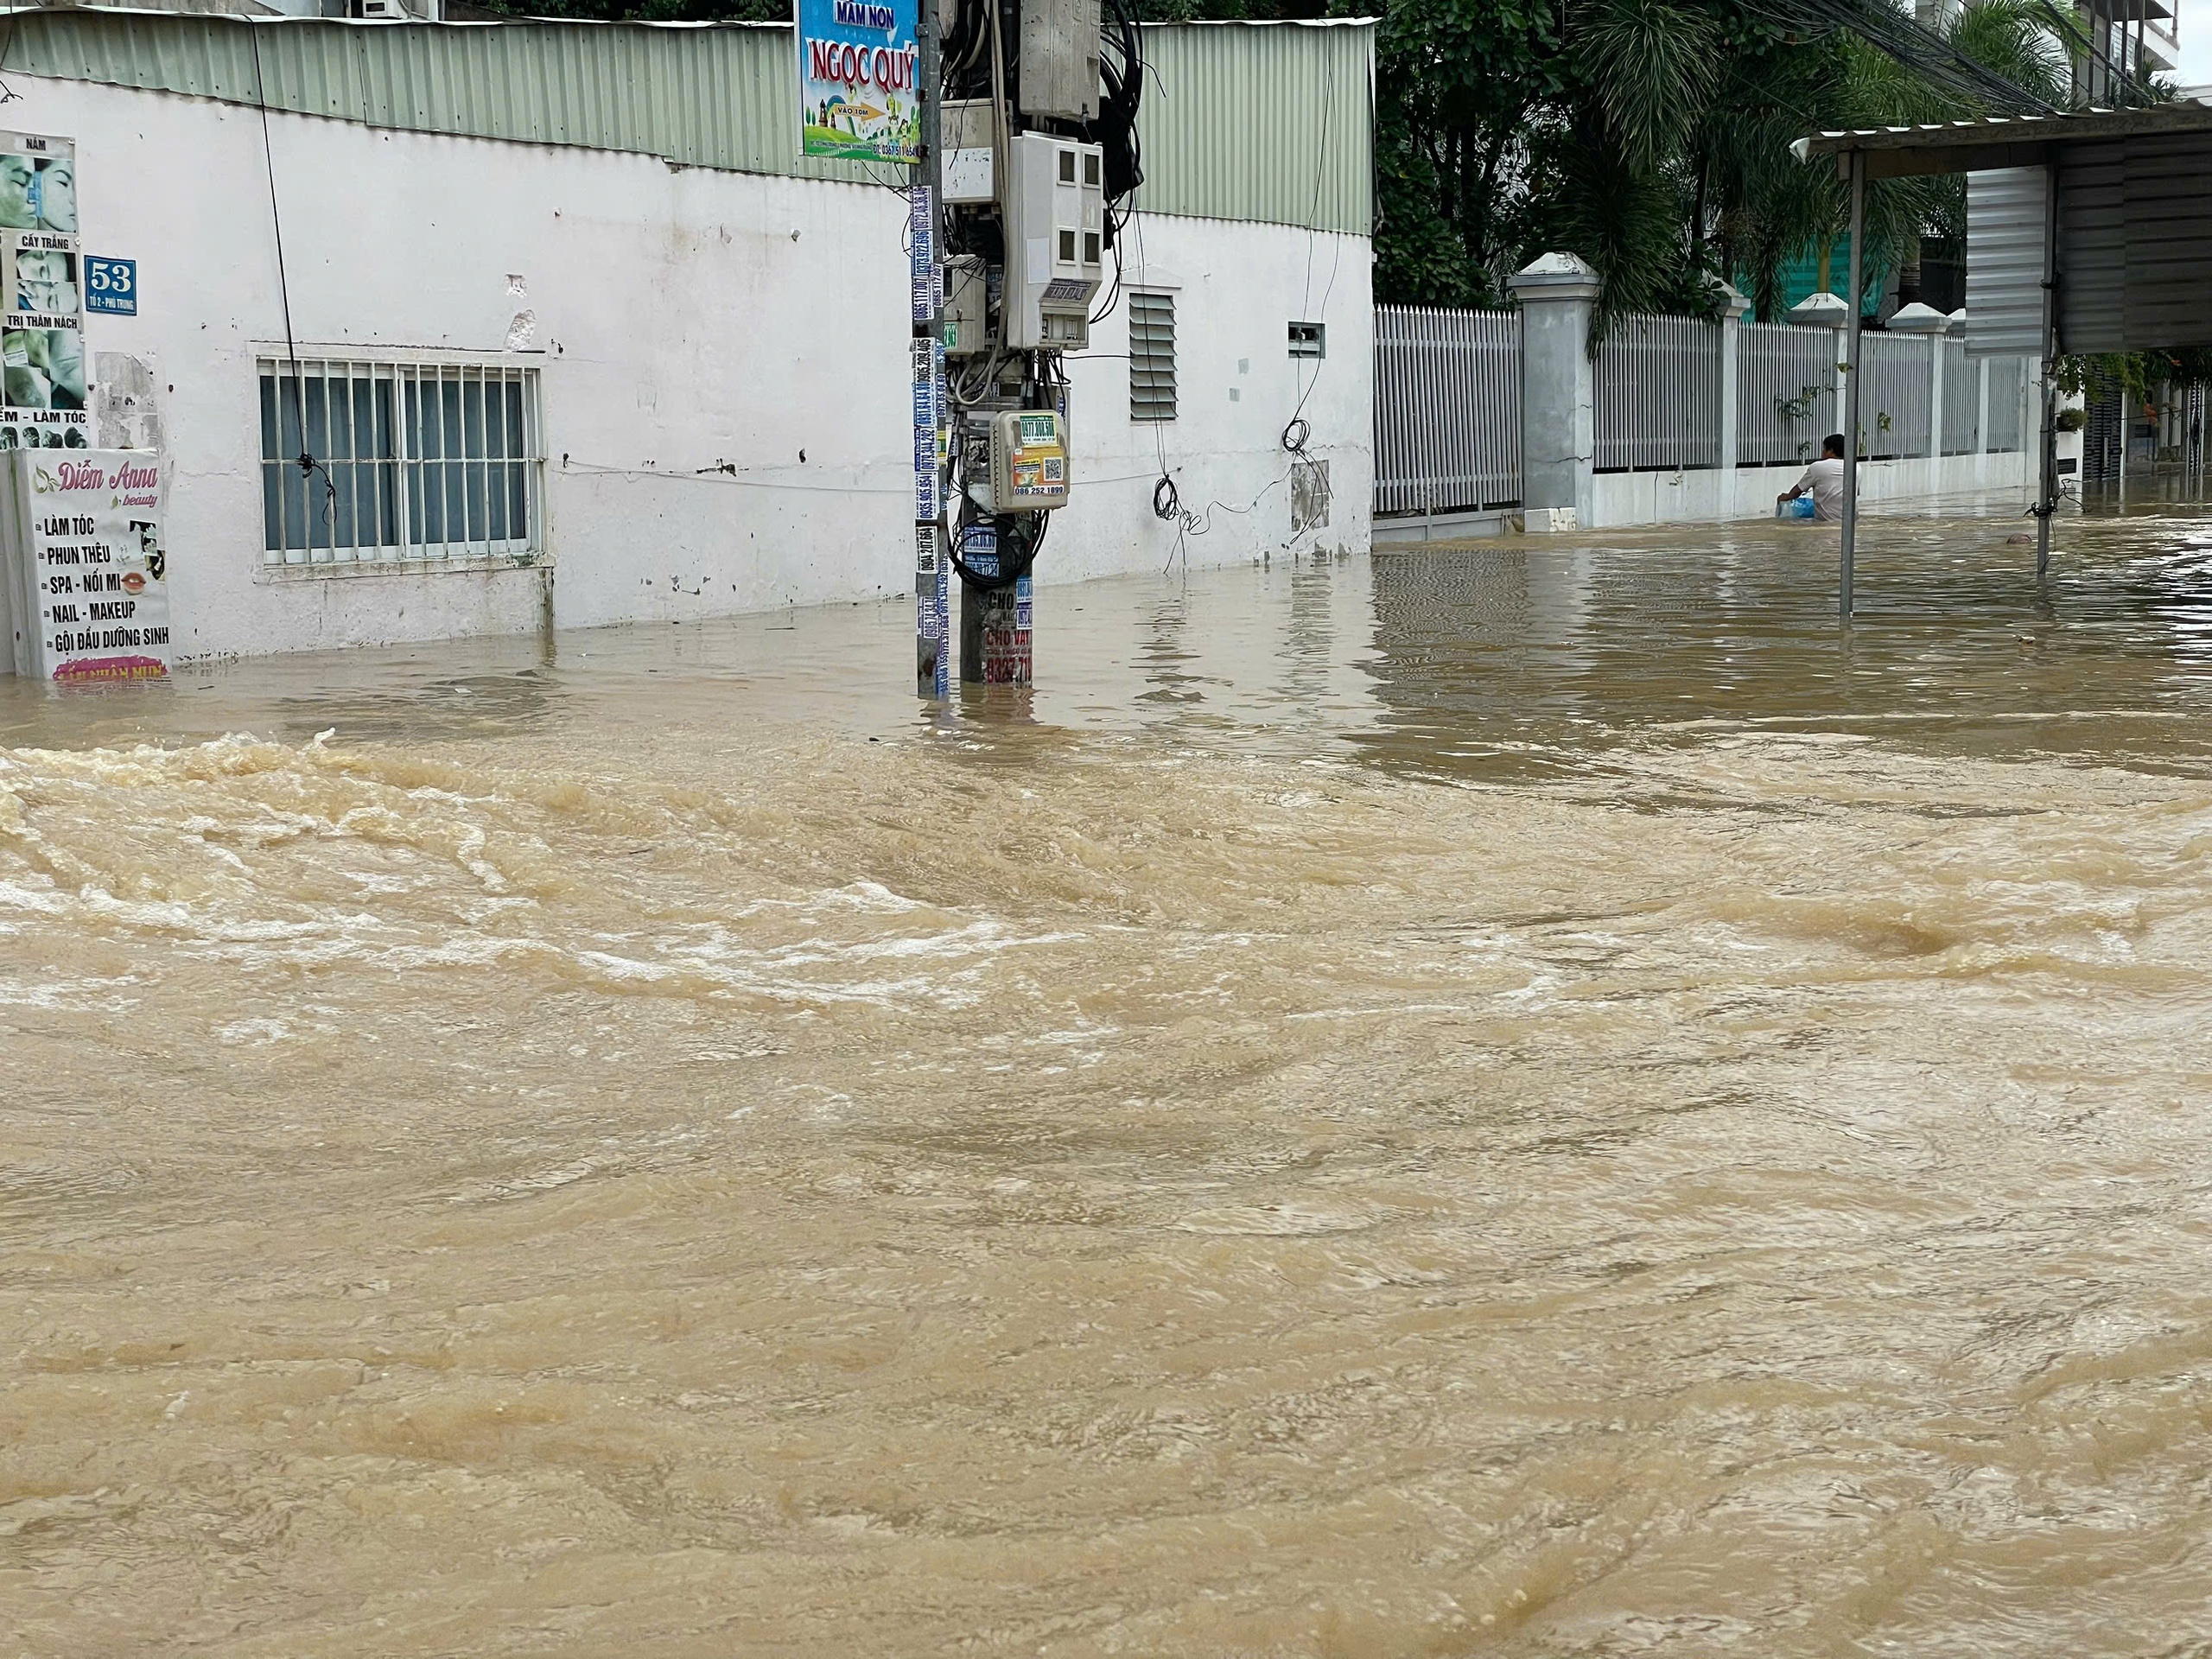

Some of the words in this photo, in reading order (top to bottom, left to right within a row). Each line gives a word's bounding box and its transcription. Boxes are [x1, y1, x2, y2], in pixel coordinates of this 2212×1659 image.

[868, 5, 895, 29] NON
[810, 40, 870, 88] NGỌC
[874, 42, 916, 94] QUÝ
[837, 105, 853, 114] VÀO
[22, 232, 39, 248] CẤY
[41, 234, 69, 250] TRẮNG
[91, 262, 131, 292] 53
[97, 296, 101, 307] 2
[7, 315, 24, 328] TRỊ
[26, 315, 52, 327] THÂM
[54, 315, 78, 328] NÁCH
[34, 410, 60, 423] LÀM
[64, 410, 86, 423] TÓC
[58, 459, 105, 492] Diễm
[108, 461, 157, 490] Anna
[122, 493, 157, 508] beauty
[44, 515, 70, 536] LÀM
[73, 513, 95, 535] TÓC
[48, 545, 80, 565] PHUN
[81, 542, 111, 563] THÊU
[50, 575, 73, 594] SPA
[83, 568, 105, 593] NỐI
[106, 572, 121, 591] MI
[52, 604, 79, 624] NAIL
[90, 601, 136, 621] MAKEUP
[55, 631, 74, 655] GỘI
[77, 626, 99, 650] ĐẦU
[103, 627, 140, 648] DƯỠNG
[143, 626, 169, 646] SINH
